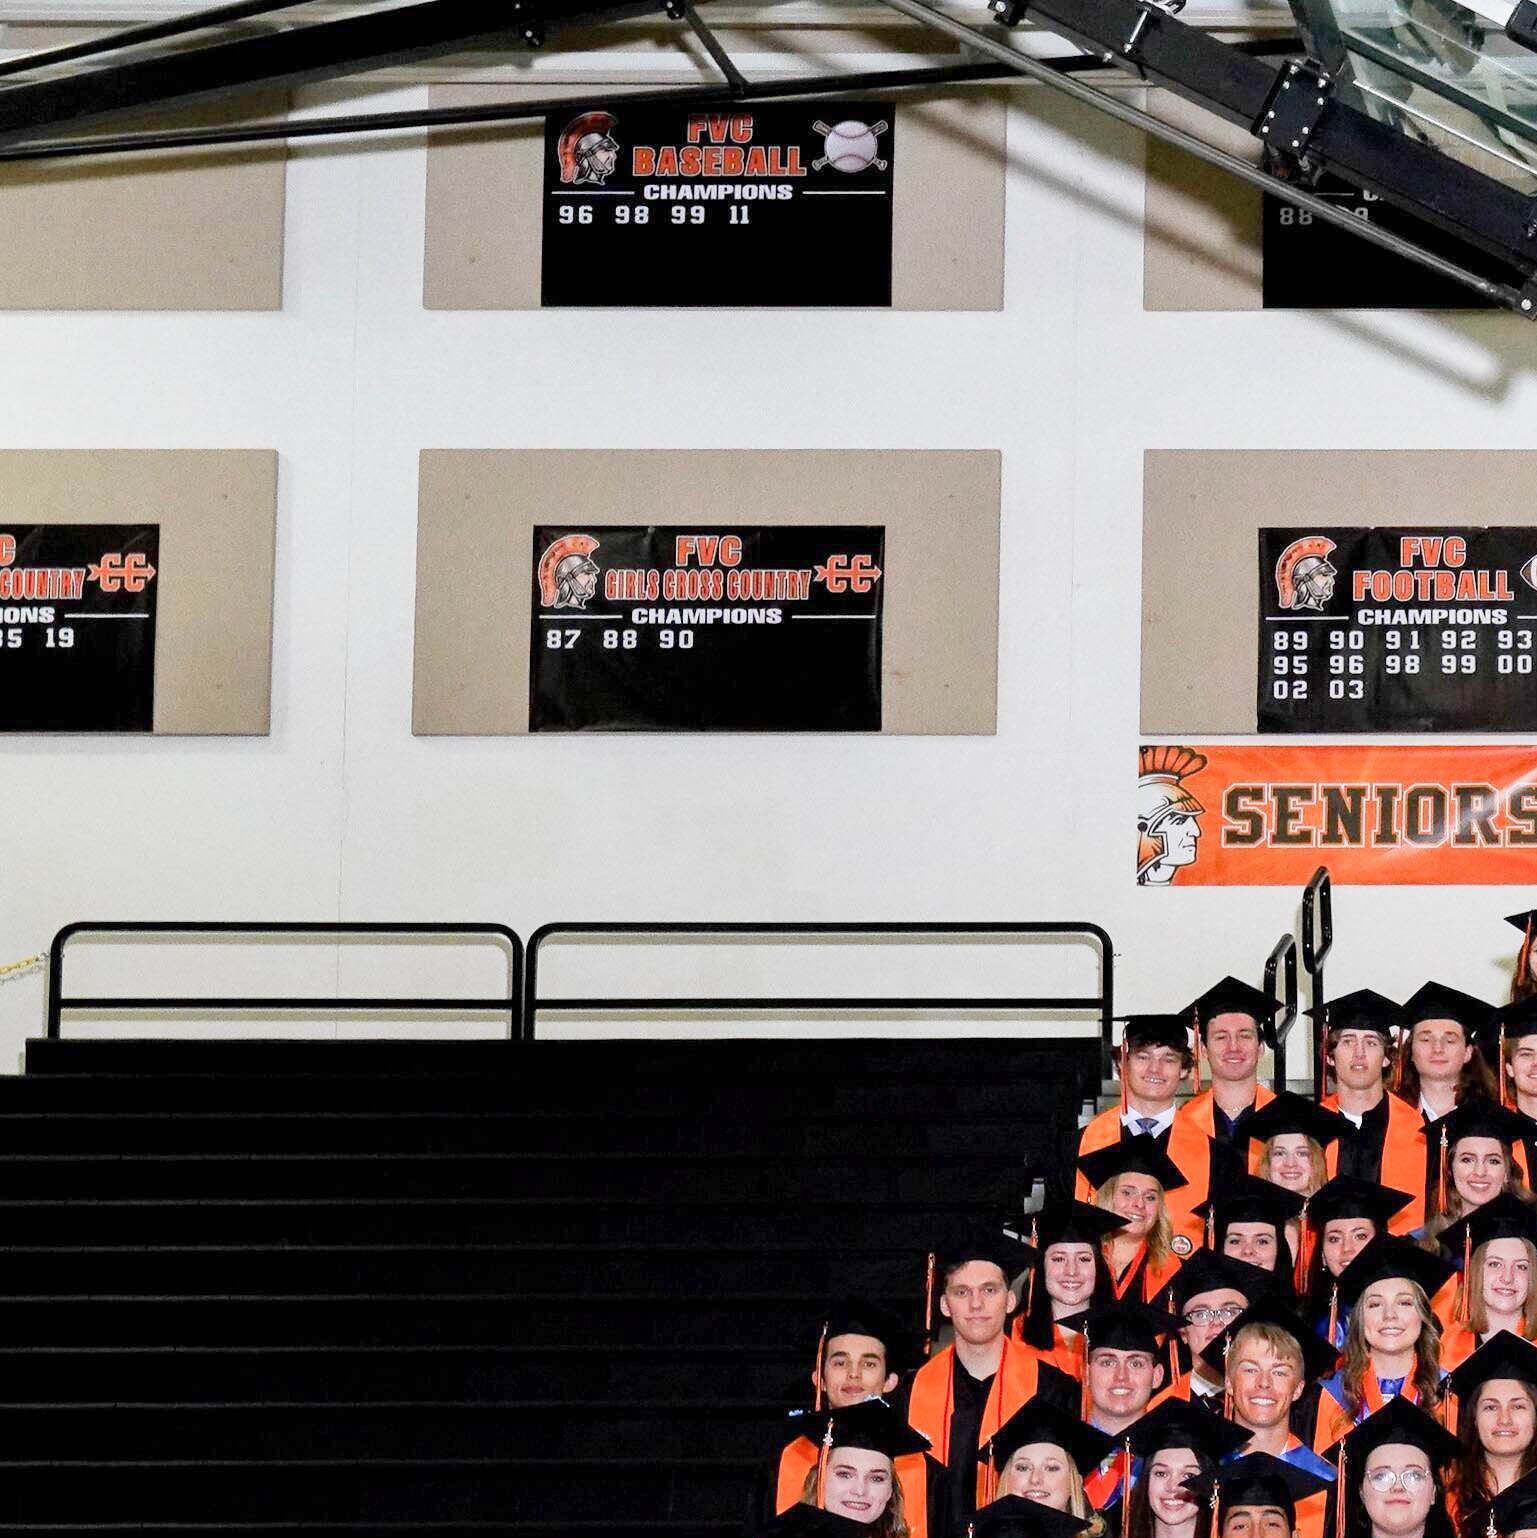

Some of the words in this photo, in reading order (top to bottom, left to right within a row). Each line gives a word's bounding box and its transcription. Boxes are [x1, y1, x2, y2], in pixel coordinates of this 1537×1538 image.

[687, 114, 753, 143] FVC
[632, 146, 807, 176] BASEBALL
[644, 184, 793, 200] CHAMPIONS
[558, 205, 593, 225] 96
[615, 205, 649, 225] 98
[671, 205, 705, 225] 99
[729, 205, 750, 225] 11
[676, 535, 742, 567] FVC
[1401, 537, 1466, 568] FVC
[604, 569, 659, 601] GIRLS
[663, 569, 723, 601] CROSS
[727, 569, 812, 601] COUNTRY
[1353, 570, 1514, 602] FOOTBALL
[631, 608, 782, 624] CHAMPIONS
[1357, 609, 1508, 625] CHAMPIONS
[45, 628, 75, 648] 19
[546, 630, 581, 649] 87
[603, 630, 638, 649] 88
[659, 630, 694, 649] 90
[1273, 630, 1308, 650] 89
[1329, 630, 1364, 650] 90
[1386, 630, 1420, 650] 91
[1441, 630, 1477, 650] 92
[1498, 630, 1532, 650] 93
[1273, 655, 1308, 675] 95
[1329, 655, 1364, 675] 96
[1386, 655, 1420, 675] 98
[1441, 655, 1477, 675] 99
[1498, 655, 1532, 675] 00
[1273, 680, 1308, 699] 02
[1329, 680, 1364, 699] 03
